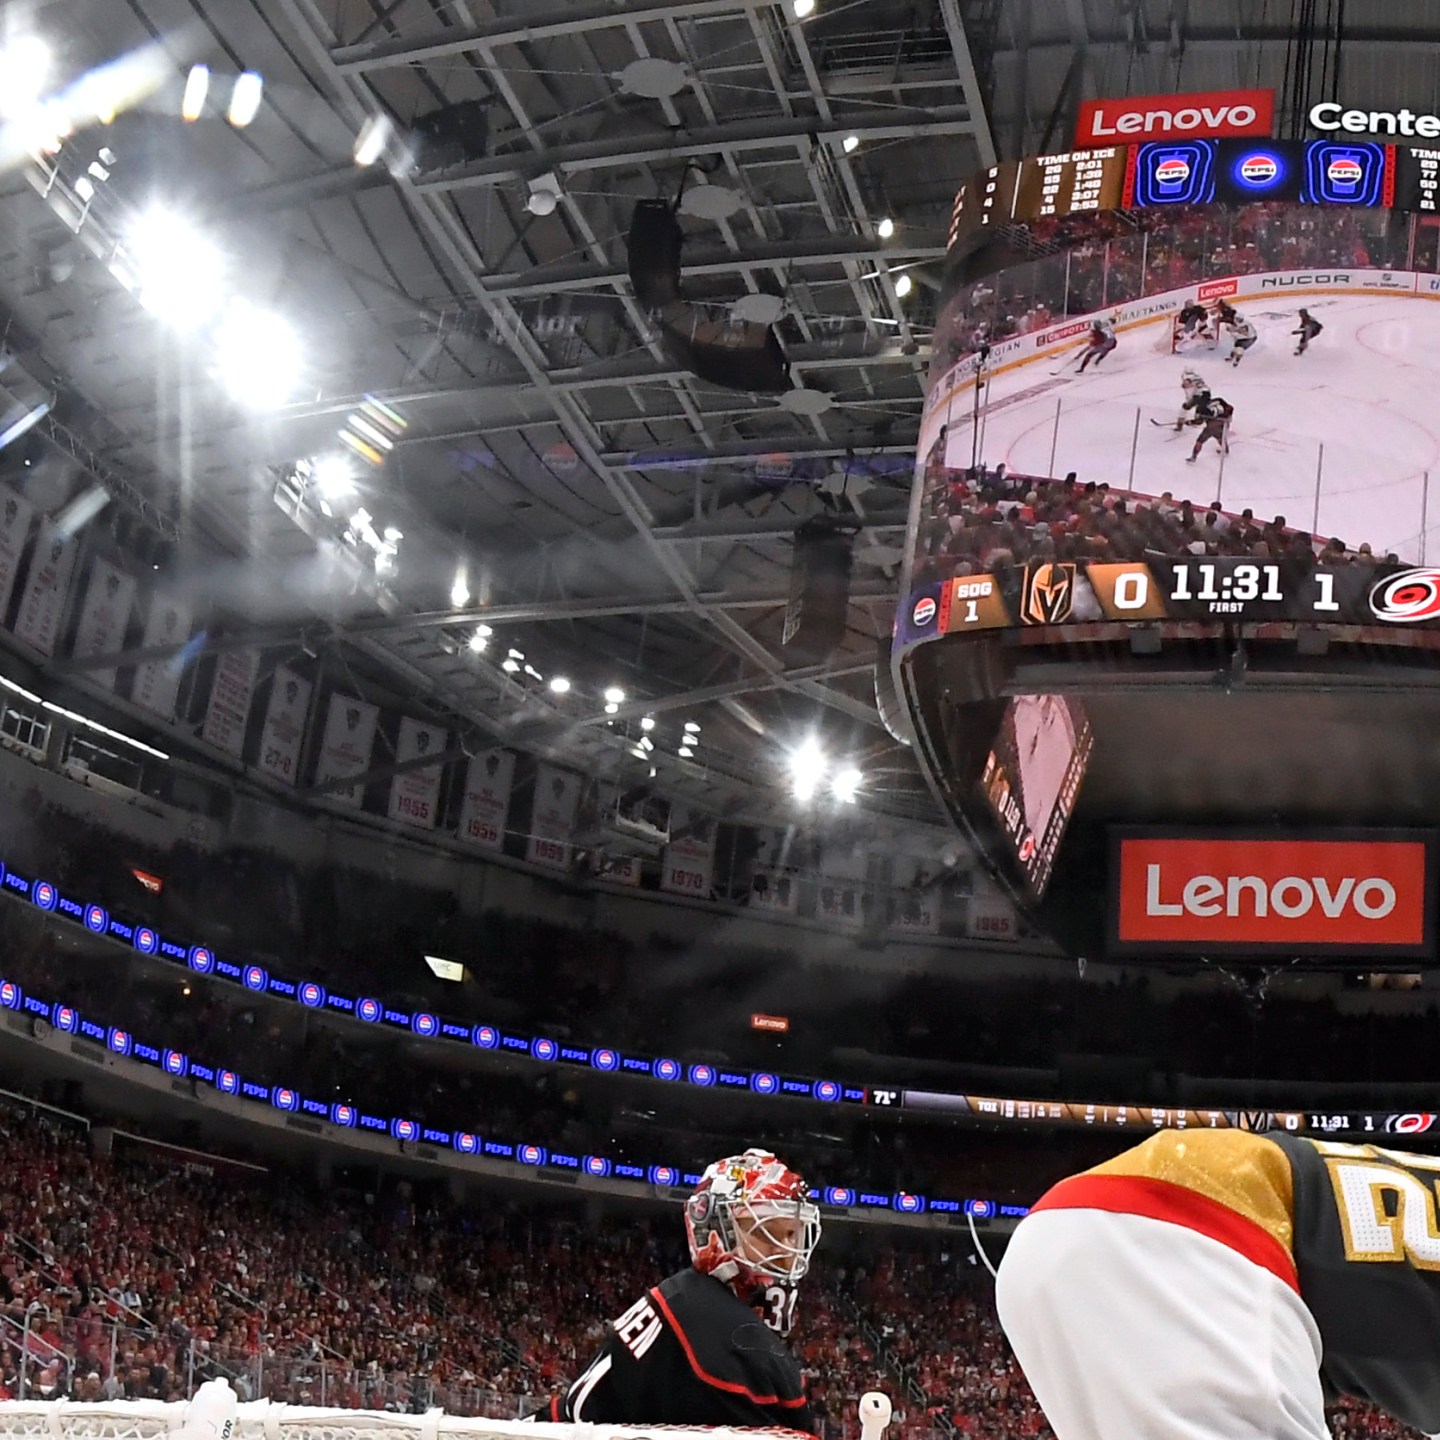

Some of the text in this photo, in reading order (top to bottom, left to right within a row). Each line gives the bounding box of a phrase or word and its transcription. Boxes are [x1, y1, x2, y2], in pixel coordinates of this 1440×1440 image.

[1092, 104, 1256, 136] Lenovo
[1037, 148, 1115, 166] TIME ON ICE
[1158, 169, 1188, 177] PEPSI
[1243, 166, 1275, 174] PEPSI
[1330, 169, 1360, 177] PEPSI
[1421, 169, 1437, 179] 77
[986, 182, 995, 193] 0
[1423, 190, 1433, 198] 4
[984, 197, 993, 207] 4
[1045, 190, 1100, 204] 4 3:07
[1040, 205, 1055, 214] 15
[981, 214, 989, 225] 1
[1262, 274, 1350, 288] NUCOR
[1200, 285, 1234, 298] Lenovo
[958, 582, 992, 598] SOG
[1171, 565, 1283, 601] 11:31
[1114, 573, 1148, 609] 0
[1313, 574, 1339, 611] 1
[965, 601, 979, 622] 1
[1209, 602, 1245, 613] FIRST
[398, 795, 428, 819] 1955
[6, 874, 28, 892] PEPSI
[1147, 864, 1396, 919] Lenovo
[60, 899, 82, 916] PEPSI
[111, 921, 131, 938] PEPSI
[976, 916, 1009, 932] 1985
[162, 942, 185, 958] PEPSI
[218, 961, 239, 976] PEPSI
[271, 979, 294, 994] PEPSI
[25, 998, 48, 1016] PEPSI
[328, 995, 352, 1009] PEPSI
[386, 1010, 408, 1024] PEPSI
[754, 1017, 786, 1029] Lenovo
[82, 1021, 104, 1039] PEPSI
[443, 1024, 468, 1037] PEPSI
[504, 1036, 527, 1049] PEPSI
[135, 1044, 158, 1060] PEPSI
[562, 1049, 587, 1061] PEPSI
[624, 1059, 649, 1070] PEPSI
[191, 1064, 212, 1080] PEPSI
[721, 1073, 746, 1085] PEPSI
[243, 1083, 267, 1098] PEPSI
[783, 1081, 809, 1093] PEPSI
[304, 1100, 327, 1114] PEPSI
[361, 1116, 386, 1129] PEPSI
[1286, 1115, 1298, 1130] 0
[1311, 1115, 1350, 1129] 11:31
[1365, 1116, 1374, 1130] 1
[424, 1130, 449, 1142] PEPSI
[485, 1143, 512, 1155] PEPSI
[552, 1155, 577, 1167] PEPSI
[615, 1165, 642, 1177] PEPSI
[860, 1195, 888, 1205] PEPSI
[930, 1201, 959, 1211] PEPSI
[1001, 1206, 1029, 1216] PEPSI
